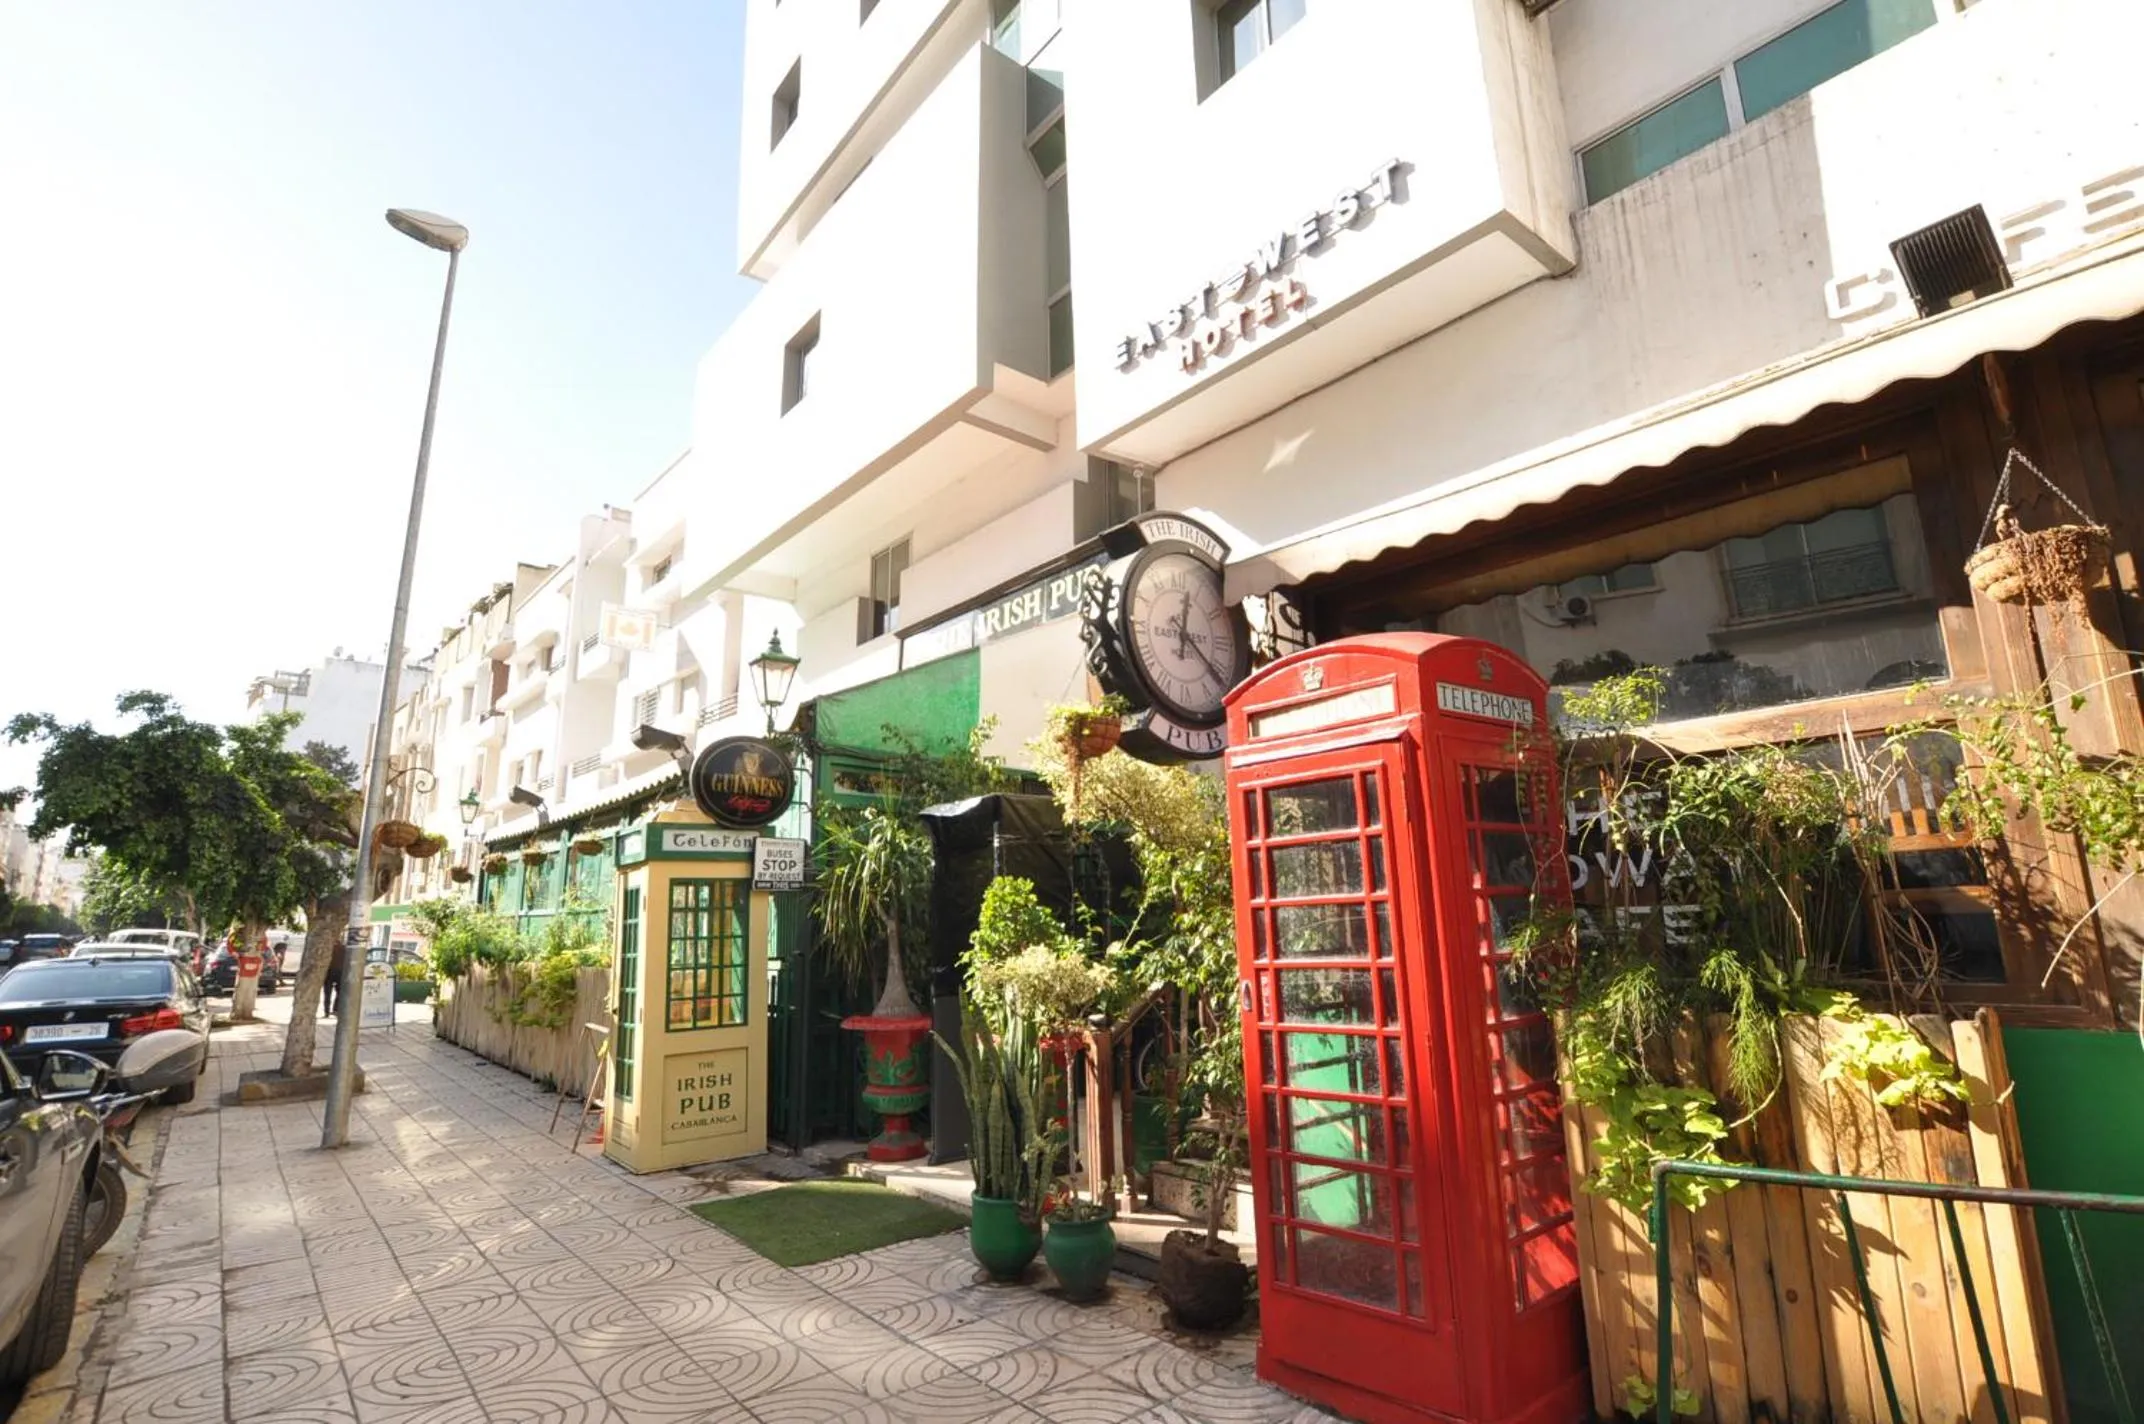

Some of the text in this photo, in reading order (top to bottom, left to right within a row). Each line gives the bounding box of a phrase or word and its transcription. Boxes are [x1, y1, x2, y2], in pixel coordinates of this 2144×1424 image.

[1252, 157, 1414, 282] WEST
[1824, 160, 2144, 326] CFE
[1178, 279, 1314, 376] HOTEL
[1145, 521, 1217, 554] THE IRISH
[976, 587, 1042, 640] IRISH
[1439, 684, 1532, 723] TELEPHONE
[1167, 724, 1223, 751] PUB
[711, 773, 785, 797] GUINNESS
[1565, 790, 1664, 837] HE
[762, 859, 797, 871] STOP
[766, 849, 793, 859] BUSES
[1575, 903, 1705, 945] AFE
[698, 1061, 715, 1071] THE
[677, 1073, 732, 1092] IRISH
[680, 1093, 732, 1115] PUB
[671, 1114, 737, 1131] CASABLANCA
